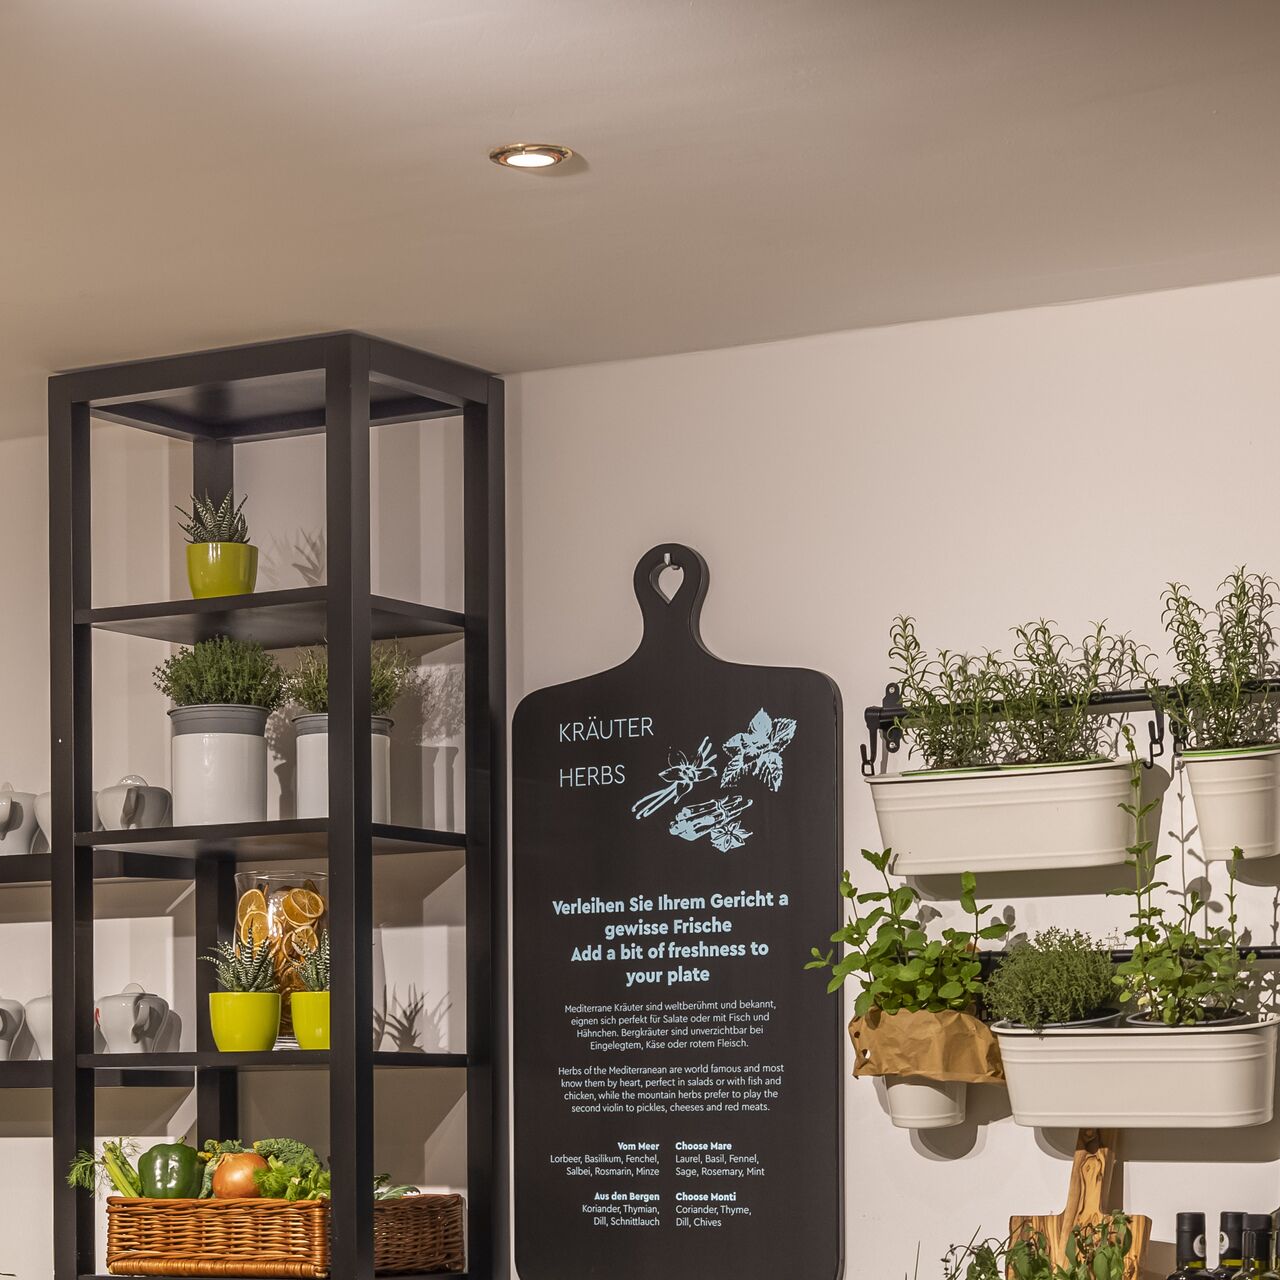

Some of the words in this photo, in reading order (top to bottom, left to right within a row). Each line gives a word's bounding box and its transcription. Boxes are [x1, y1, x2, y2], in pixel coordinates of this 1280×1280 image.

[559, 716, 654, 742] KRÄUTER
[560, 764, 625, 787] HERBS
[552, 897, 624, 915] Verleihen
[629, 894, 653, 911] Sie
[658, 894, 705, 910] Ihrem
[710, 890, 774, 908] Gericht
[778, 893, 788, 906] a
[604, 918, 668, 940] gewisse
[673, 916, 732, 934] Frische
[570, 944, 601, 961] Add
[606, 948, 615, 960] a
[620, 942, 643, 959] bit
[647, 942, 665, 958] of
[668, 940, 746, 958] freshness
[750, 941, 769, 955] to
[626, 971, 663, 987] your
[667, 965, 710, 985] plate
[564, 1003, 612, 1013] Mediterrane
[614, 1002, 643, 1011] Kräuter
[645, 1001, 662, 1011] sind
[664, 1000, 718, 1010] weltberühmt
[720, 999, 737, 1009] und
[739, 999, 776, 1009] bekannt,
[570, 1016, 598, 1027] eignen
[600, 1015, 616, 1024] sich
[618, 1014, 647, 1026] perfekt
[649, 1014, 661, 1023] für
[662, 1014, 688, 1023] Salate
[690, 1013, 710, 1023] oder
[712, 1013, 726, 1022] mit
[728, 1012, 751, 1021] Fisch
[753, 1011, 770, 1021] und
[576, 1028, 619, 1037] Hähnchen.
[621, 1027, 669, 1038] Bergkräuter
[671, 1026, 688, 1035] sind
[690, 1025, 747, 1035] unverzichtbar
[749, 1024, 764, 1034] bei
[590, 1040, 644, 1051] Eingelegtem,
[646, 1039, 666, 1048] Käse
[667, 1039, 687, 1048] oder
[689, 1040, 715, 1048] rotem
[717, 1038, 749, 1047] Fleisch.
[558, 1066, 582, 1075] Herbs
[583, 1065, 592, 1075] of
[593, 1065, 607, 1074] the
[608, 1065, 667, 1074] Mediterranean
[683, 1064, 708, 1073] world
[710, 1063, 742, 1073] famous
[743, 1063, 760, 1072] and
[762, 1064, 784, 1072] most
[617, 1142, 636, 1150] Vom
[638, 1142, 660, 1150] Meer
[675, 1141, 708, 1150] Choose
[710, 1141, 732, 1150] Mare
[550, 1154, 583, 1164] Lorbeer,
[584, 1154, 624, 1164] Basilikum,
[625, 1154, 659, 1164] Fenchel,
[675, 1153, 702, 1164] Laurel,
[705, 1153, 727, 1164] Basil,
[729, 1153, 759, 1164] Fennel,
[566, 1166, 592, 1176] Salbei,
[594, 1166, 634, 1176] Rosmarin,
[636, 1166, 659, 1175] Minze
[675, 1166, 699, 1177] Sage,
[701, 1166, 744, 1177] Rosemary,
[746, 1166, 765, 1175] Mint
[594, 1192, 610, 1200] Aus
[611, 1191, 627, 1200] den
[629, 1192, 660, 1202] Bergen
[675, 1191, 709, 1201] Choose
[710, 1191, 736, 1201] Monti
[582, 1204, 621, 1214] Koriander,
[622, 1204, 659, 1215] Thymian,
[675, 1204, 719, 1215] Coriander,
[720, 1204, 751, 1215] Thyme,
[593, 1216, 609, 1227] Dill,
[610, 1216, 660, 1226] Schnittlauch
[676, 1217, 691, 1227] Dill,
[693, 1217, 722, 1226] Chives
